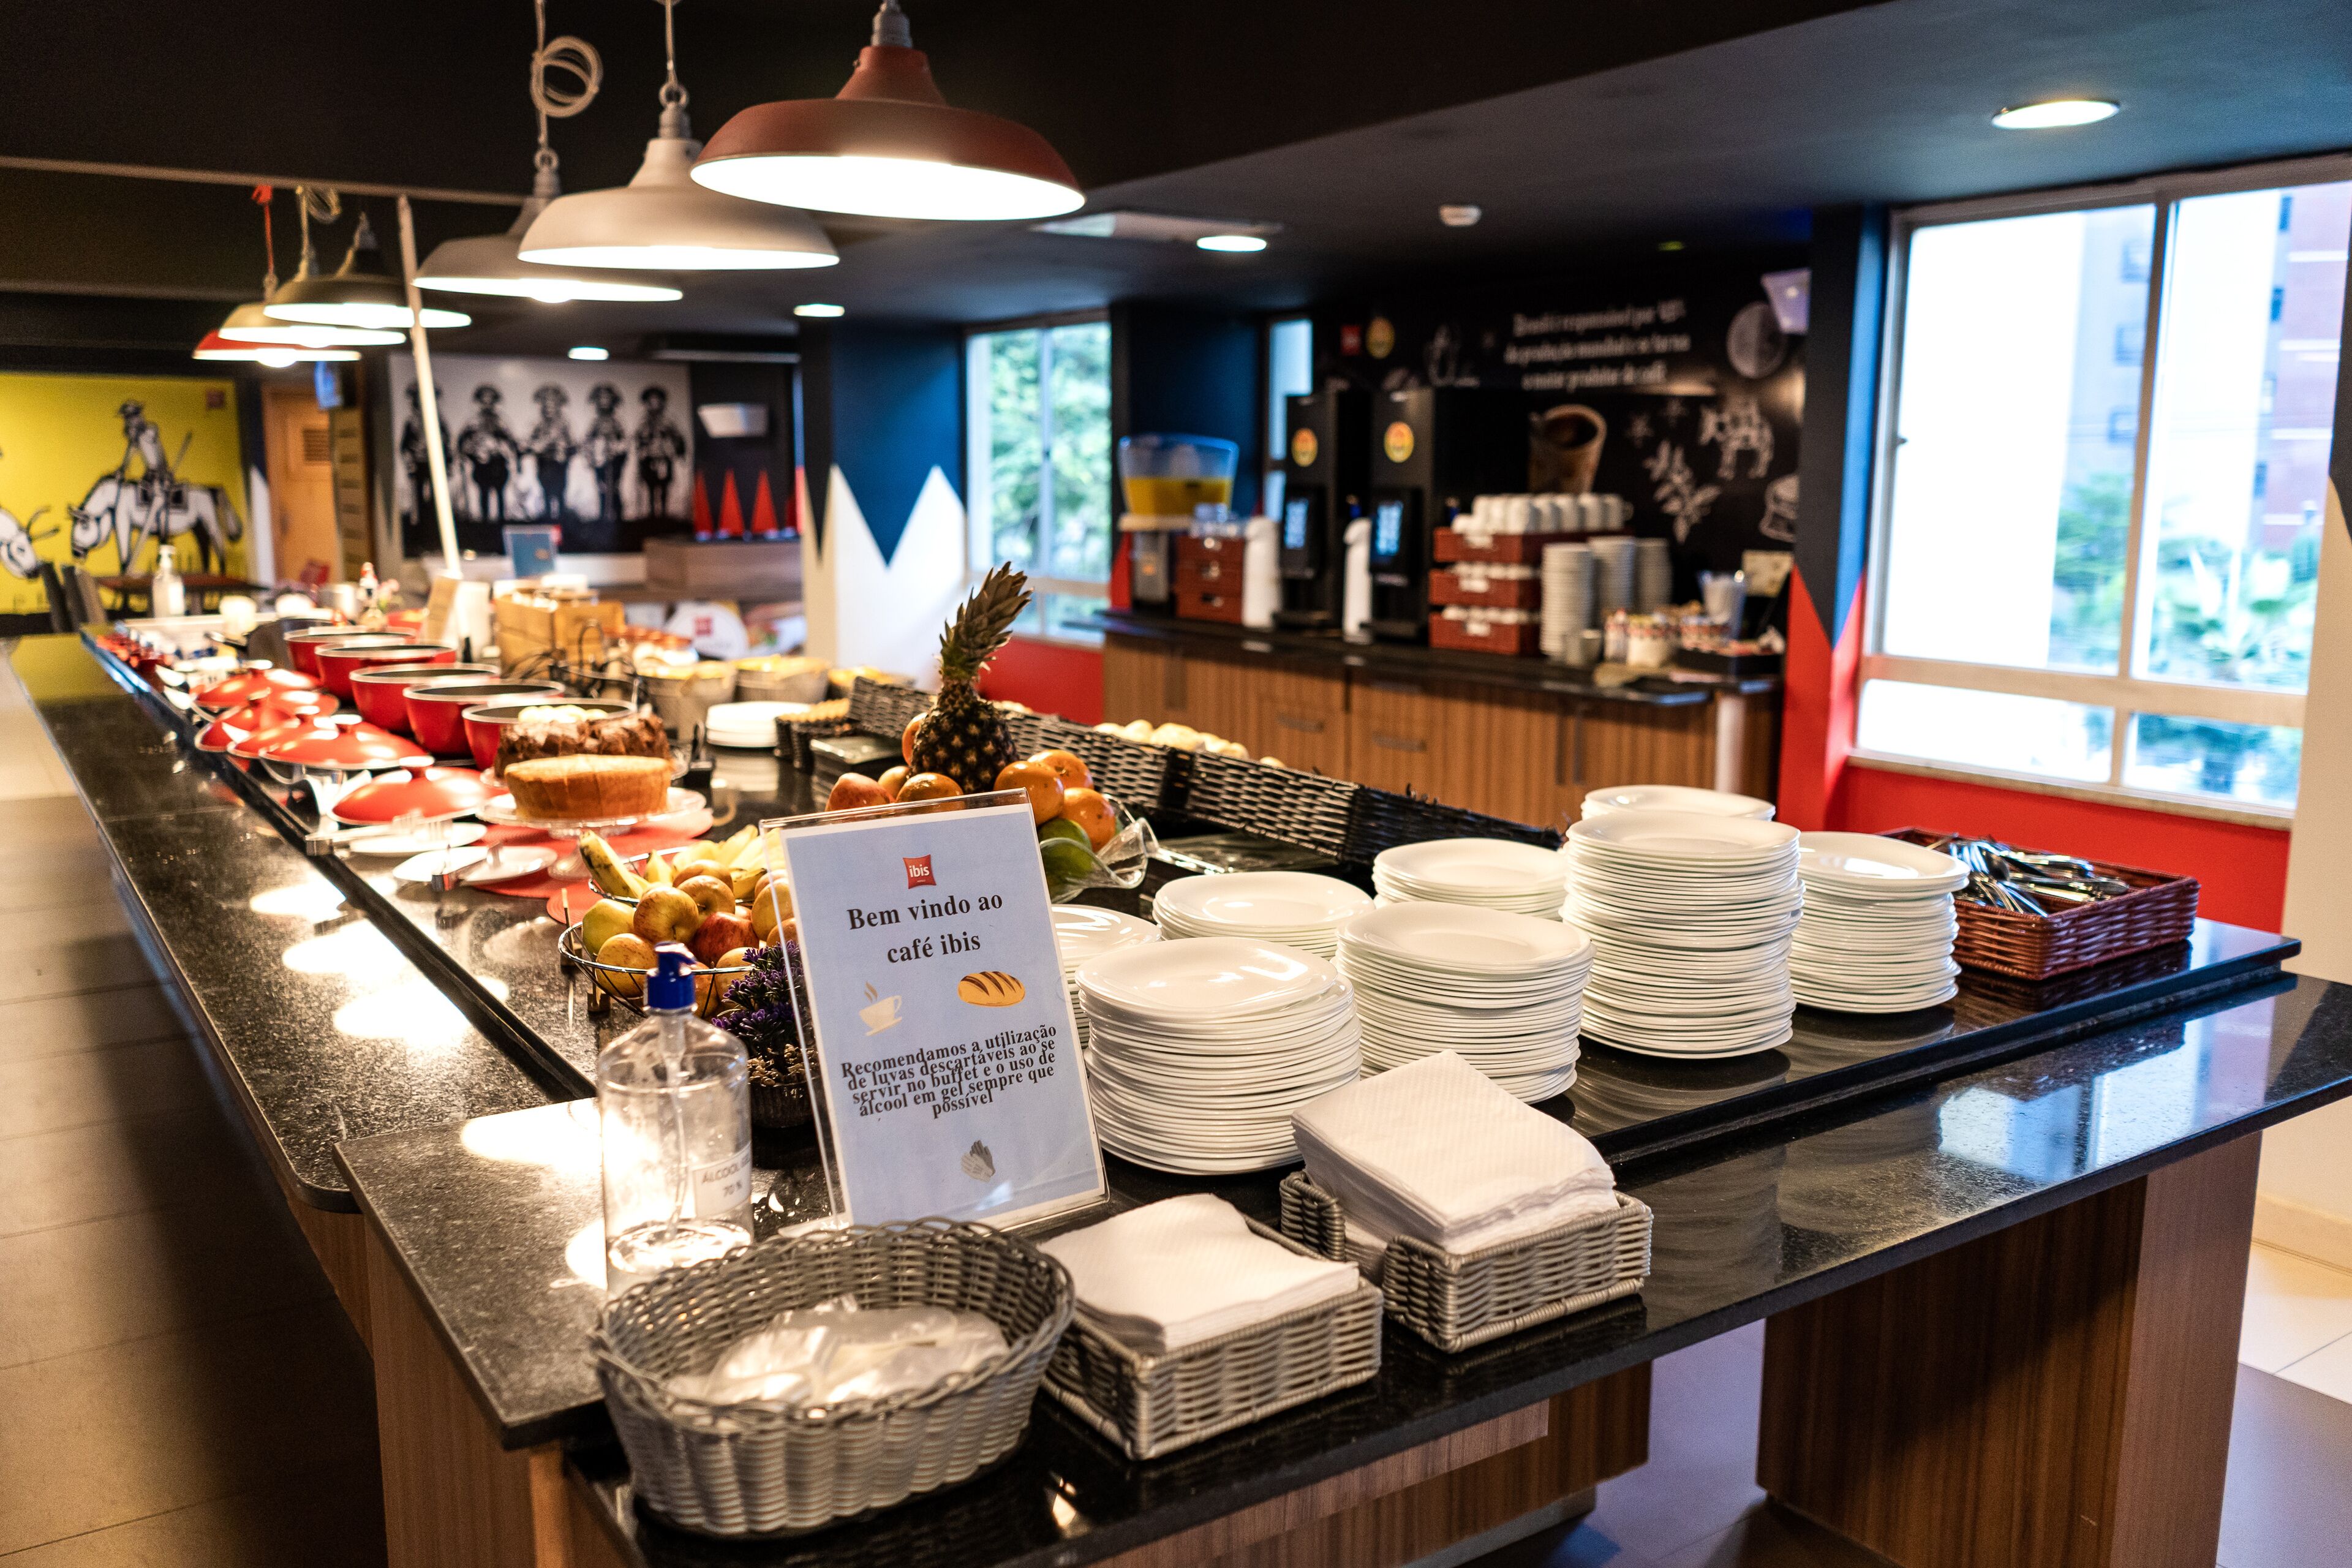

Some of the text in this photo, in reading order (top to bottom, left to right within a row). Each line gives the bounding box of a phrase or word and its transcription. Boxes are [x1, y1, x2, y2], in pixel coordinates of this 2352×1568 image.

[909, 864, 930, 878] ibis
[846, 894, 1003, 930] Bem vindo ao
[887, 931, 981, 963] café ibis
[840, 1024, 1057, 1078] Recomendamos a utilização
[848, 1039, 1056, 1091] de luvas descartáveis ao se
[853, 1050, 1056, 1104] servir no buffet e o uso de
[859, 1066, 1055, 1117] álcool em gel sempre que
[932, 1088, 993, 1119] possível
